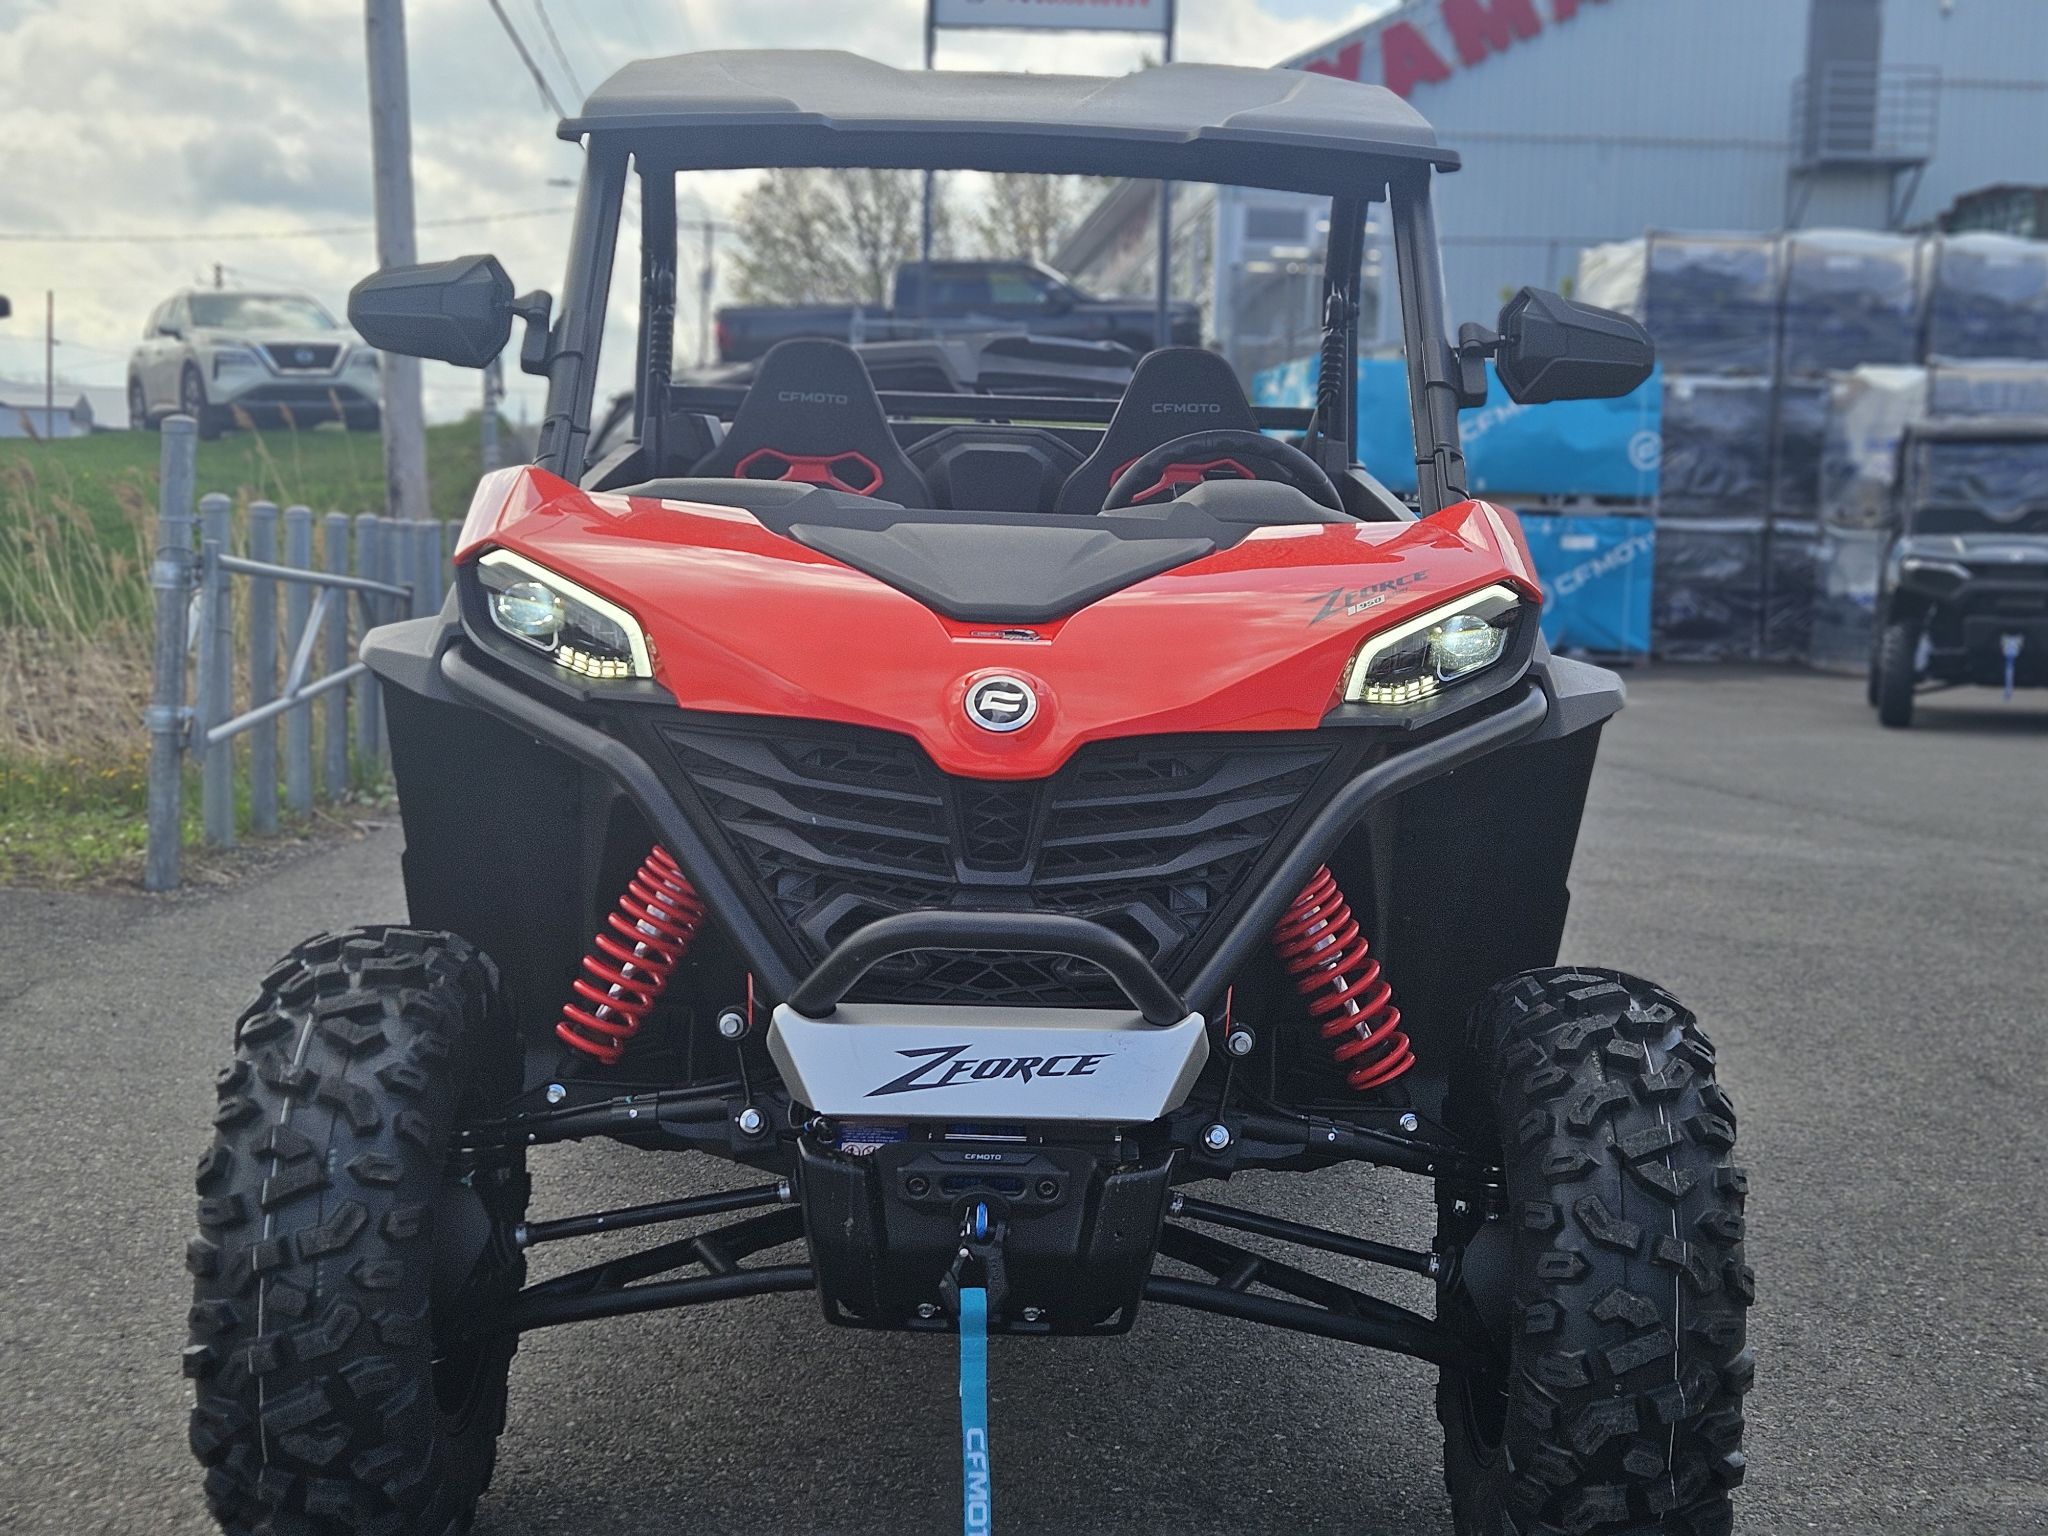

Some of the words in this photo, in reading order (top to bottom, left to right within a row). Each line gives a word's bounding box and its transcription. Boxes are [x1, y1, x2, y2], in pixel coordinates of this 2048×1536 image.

[778, 391, 848, 406] CFMOTO
[1151, 403, 1221, 414] CFMOTO
[1304, 569, 1430, 628] ZFORCE
[863, 1044, 1117, 1097] ZFORCE
[964, 1153, 1002, 1161] CFMOTO
